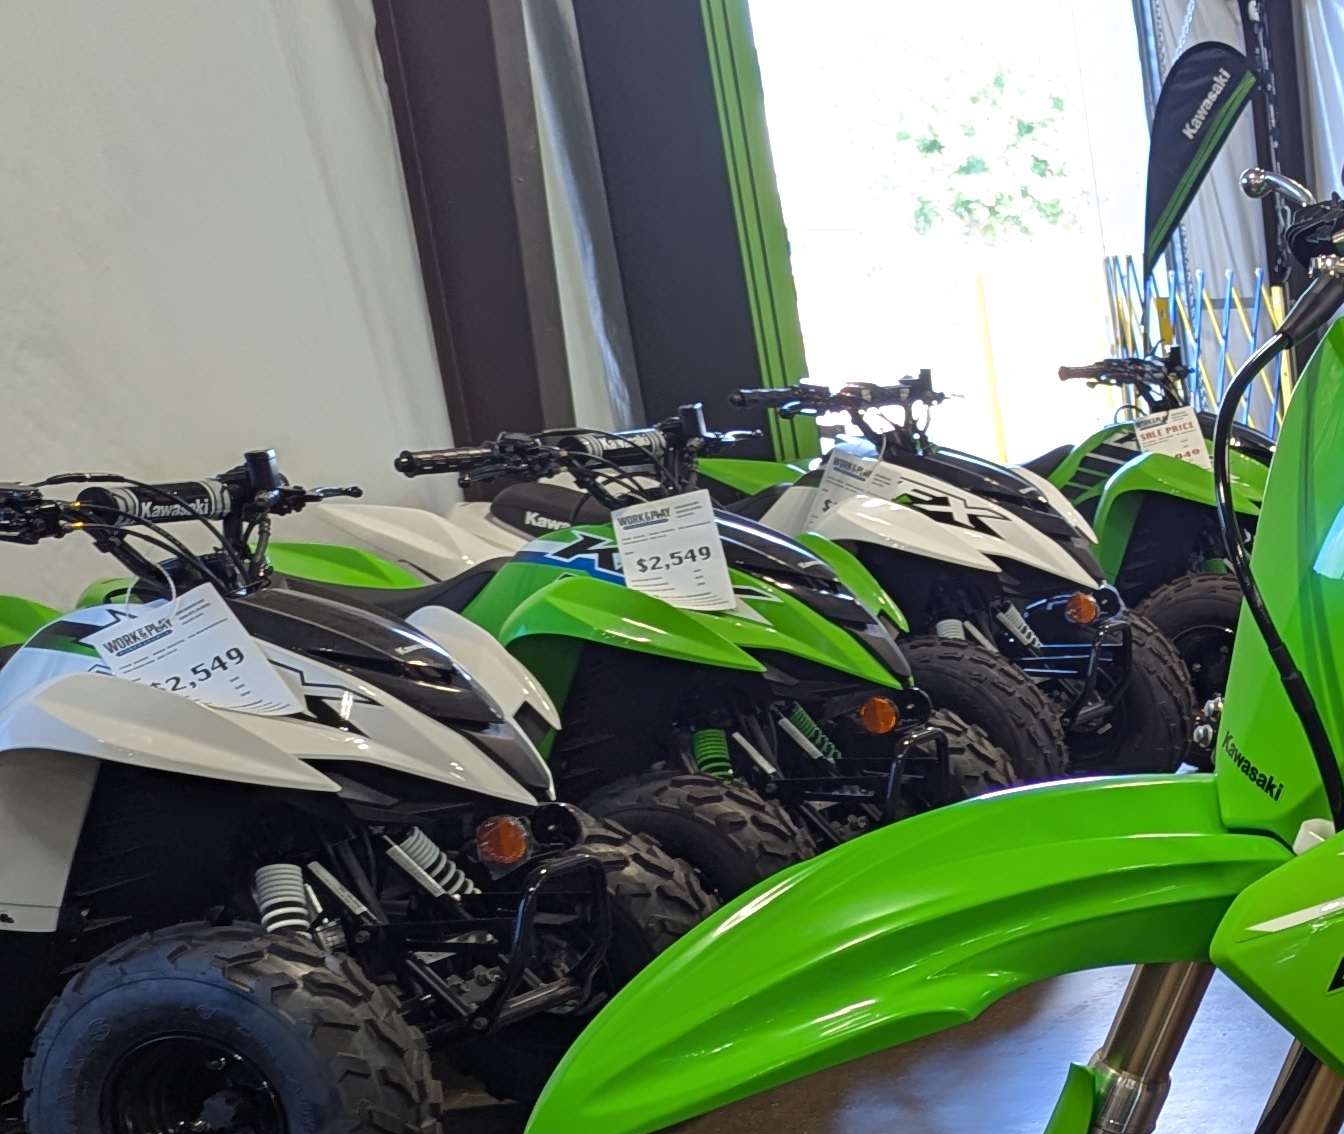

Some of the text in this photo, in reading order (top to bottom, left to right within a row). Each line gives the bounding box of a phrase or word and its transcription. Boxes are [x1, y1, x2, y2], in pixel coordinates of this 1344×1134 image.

[1181, 67, 1232, 140] Kawasaki
[636, 546, 712, 573] $2,549
[1222, 731, 1284, 802] Kawasaki
